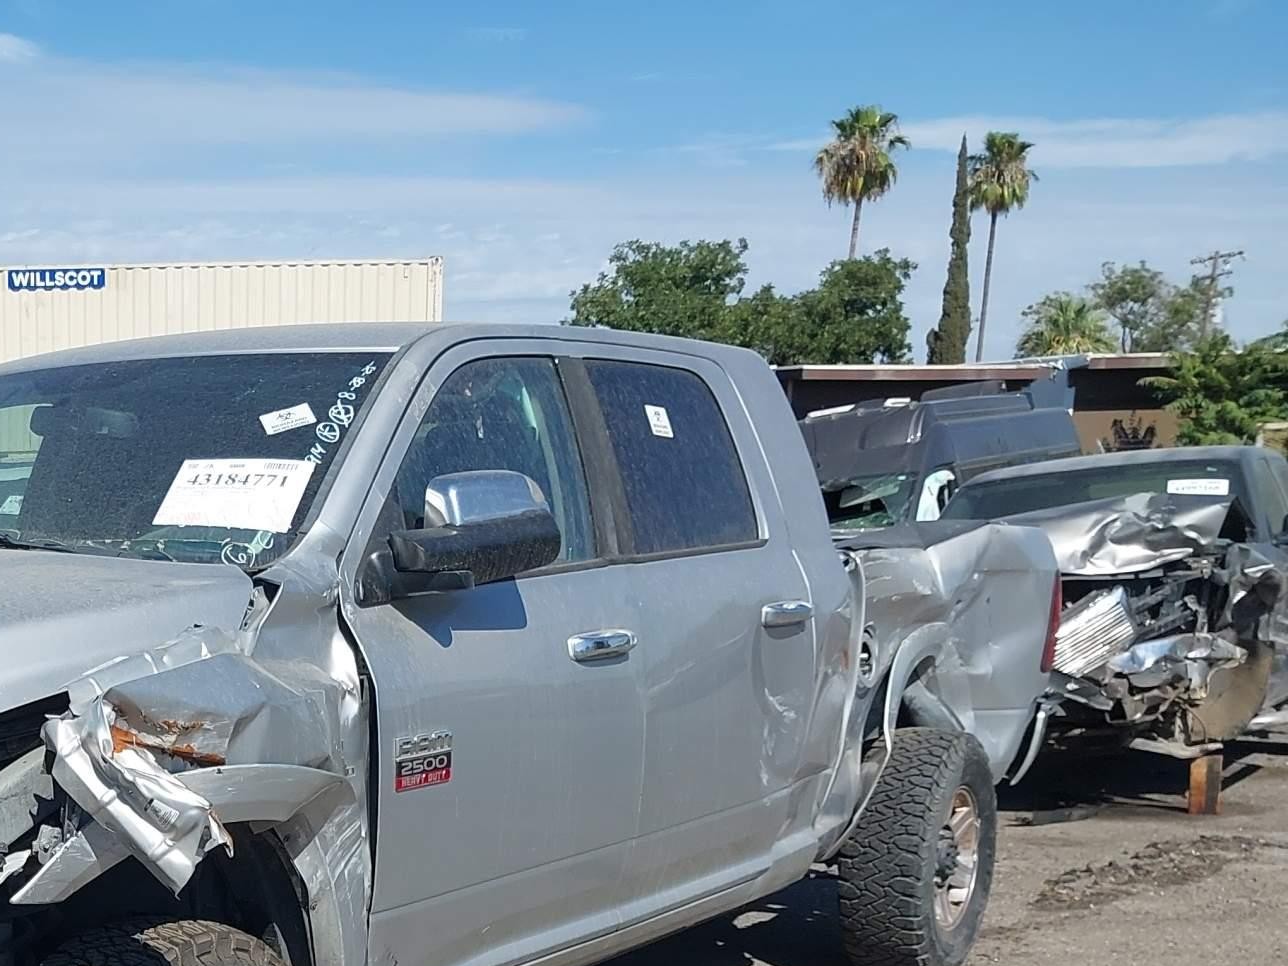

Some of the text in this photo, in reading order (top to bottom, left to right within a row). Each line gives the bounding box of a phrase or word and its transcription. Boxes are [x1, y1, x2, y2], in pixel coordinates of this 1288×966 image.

[11, 270, 102, 287] WILLSCOT
[187, 473, 289, 488] 43184771
[401, 755, 448, 776] 2500
